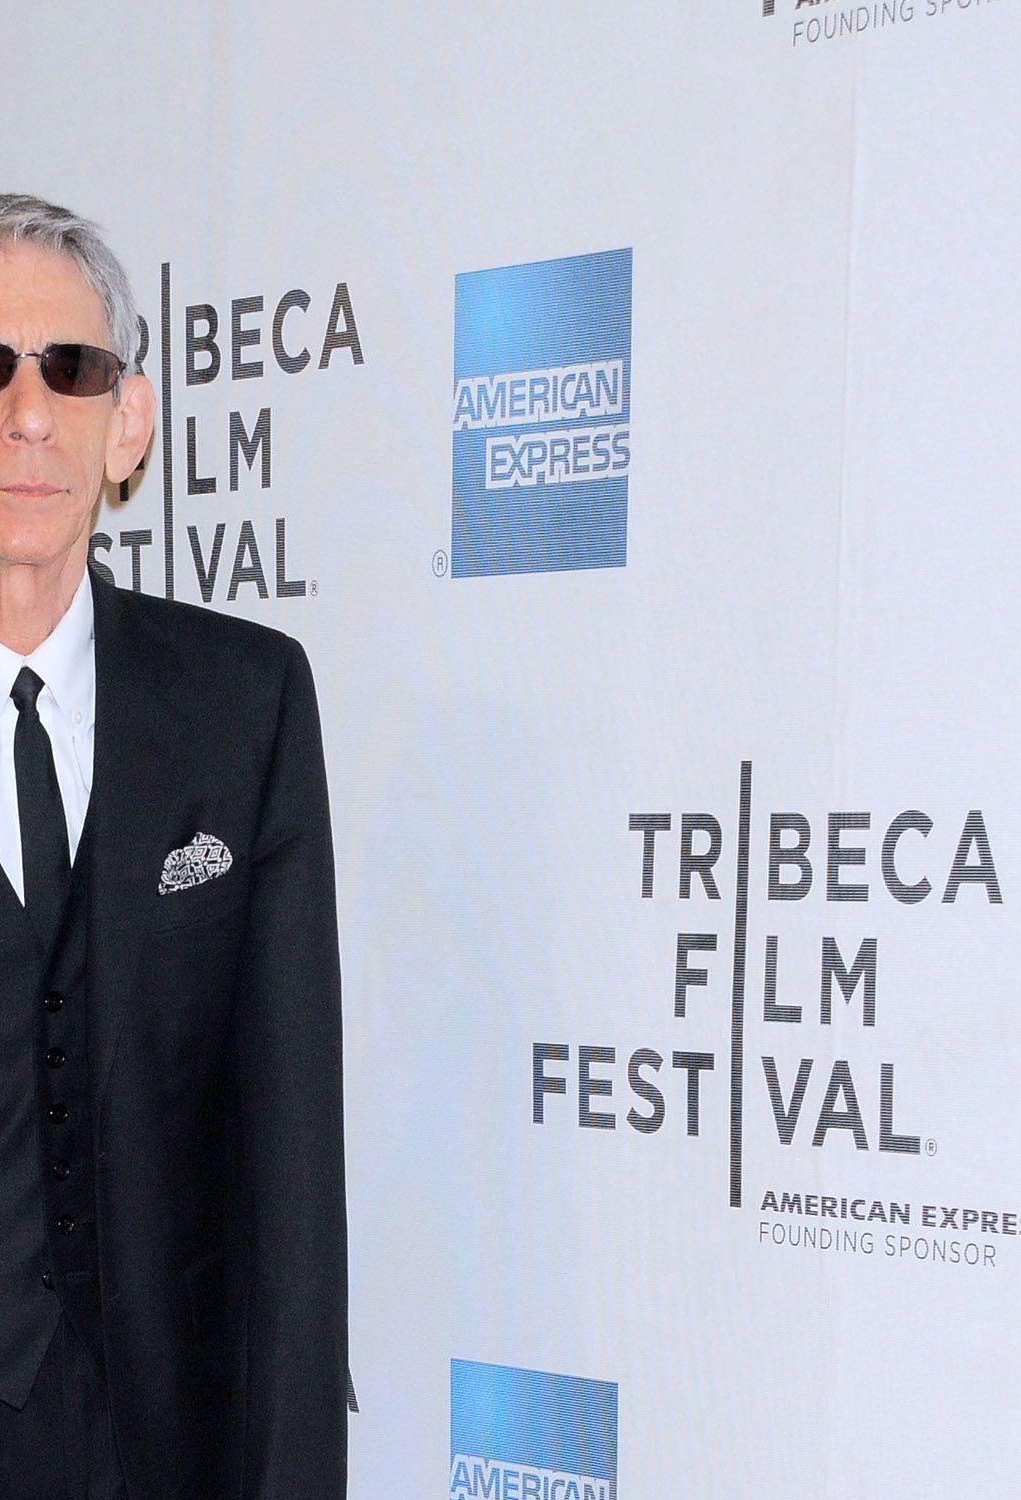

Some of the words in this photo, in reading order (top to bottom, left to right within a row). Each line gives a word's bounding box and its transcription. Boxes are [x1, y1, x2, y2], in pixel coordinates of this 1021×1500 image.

[792, 0, 913, 46] FOUNDING
[136, 282, 365, 387] IBECA
[452, 367, 621, 426] AMERICAN
[119, 407, 272, 501] ILM
[488, 430, 631, 484] EXPRESS
[88, 517, 307, 604] STIVAL
[628, 809, 1003, 904] TRIBECA
[674, 933, 877, 1027] FILM
[532, 1042, 921, 1156] FESTIVAL
[759, 1221, 874, 1255] FOUNDING
[885, 1234, 996, 1268] SPONSOR
[760, 1190, 910, 1225] AMERICAN
[922, 1205, 1021, 1236] EXPRE
